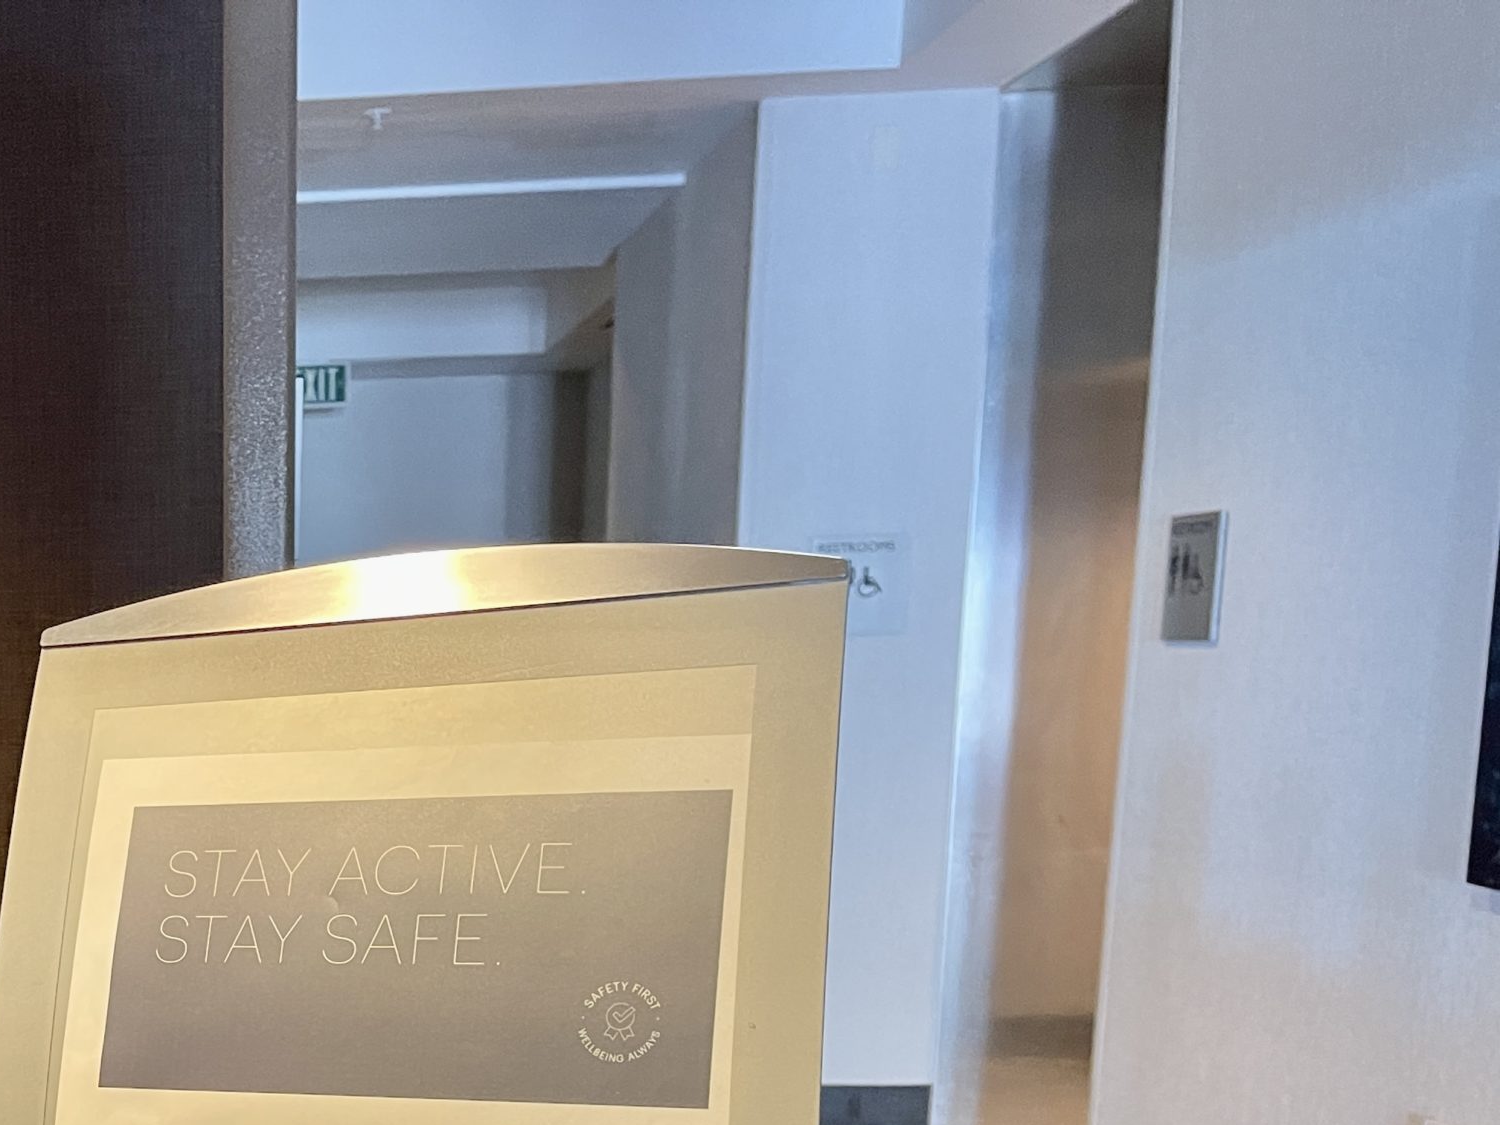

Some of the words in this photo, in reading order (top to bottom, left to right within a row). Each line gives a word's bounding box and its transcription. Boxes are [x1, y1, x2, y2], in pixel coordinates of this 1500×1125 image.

[297, 368, 339, 401] XIT
[165, 848, 311, 897] STAY
[329, 843, 585, 895] ACTIVE.
[156, 915, 302, 963] STAY
[322, 914, 500, 965] SAFE.
[584, 981, 629, 1009] SAFETY
[631, 983, 661, 1010] FIRST
[578, 1027, 624, 1063] WELLBEING
[628, 1030, 661, 1062] ALWAYS
